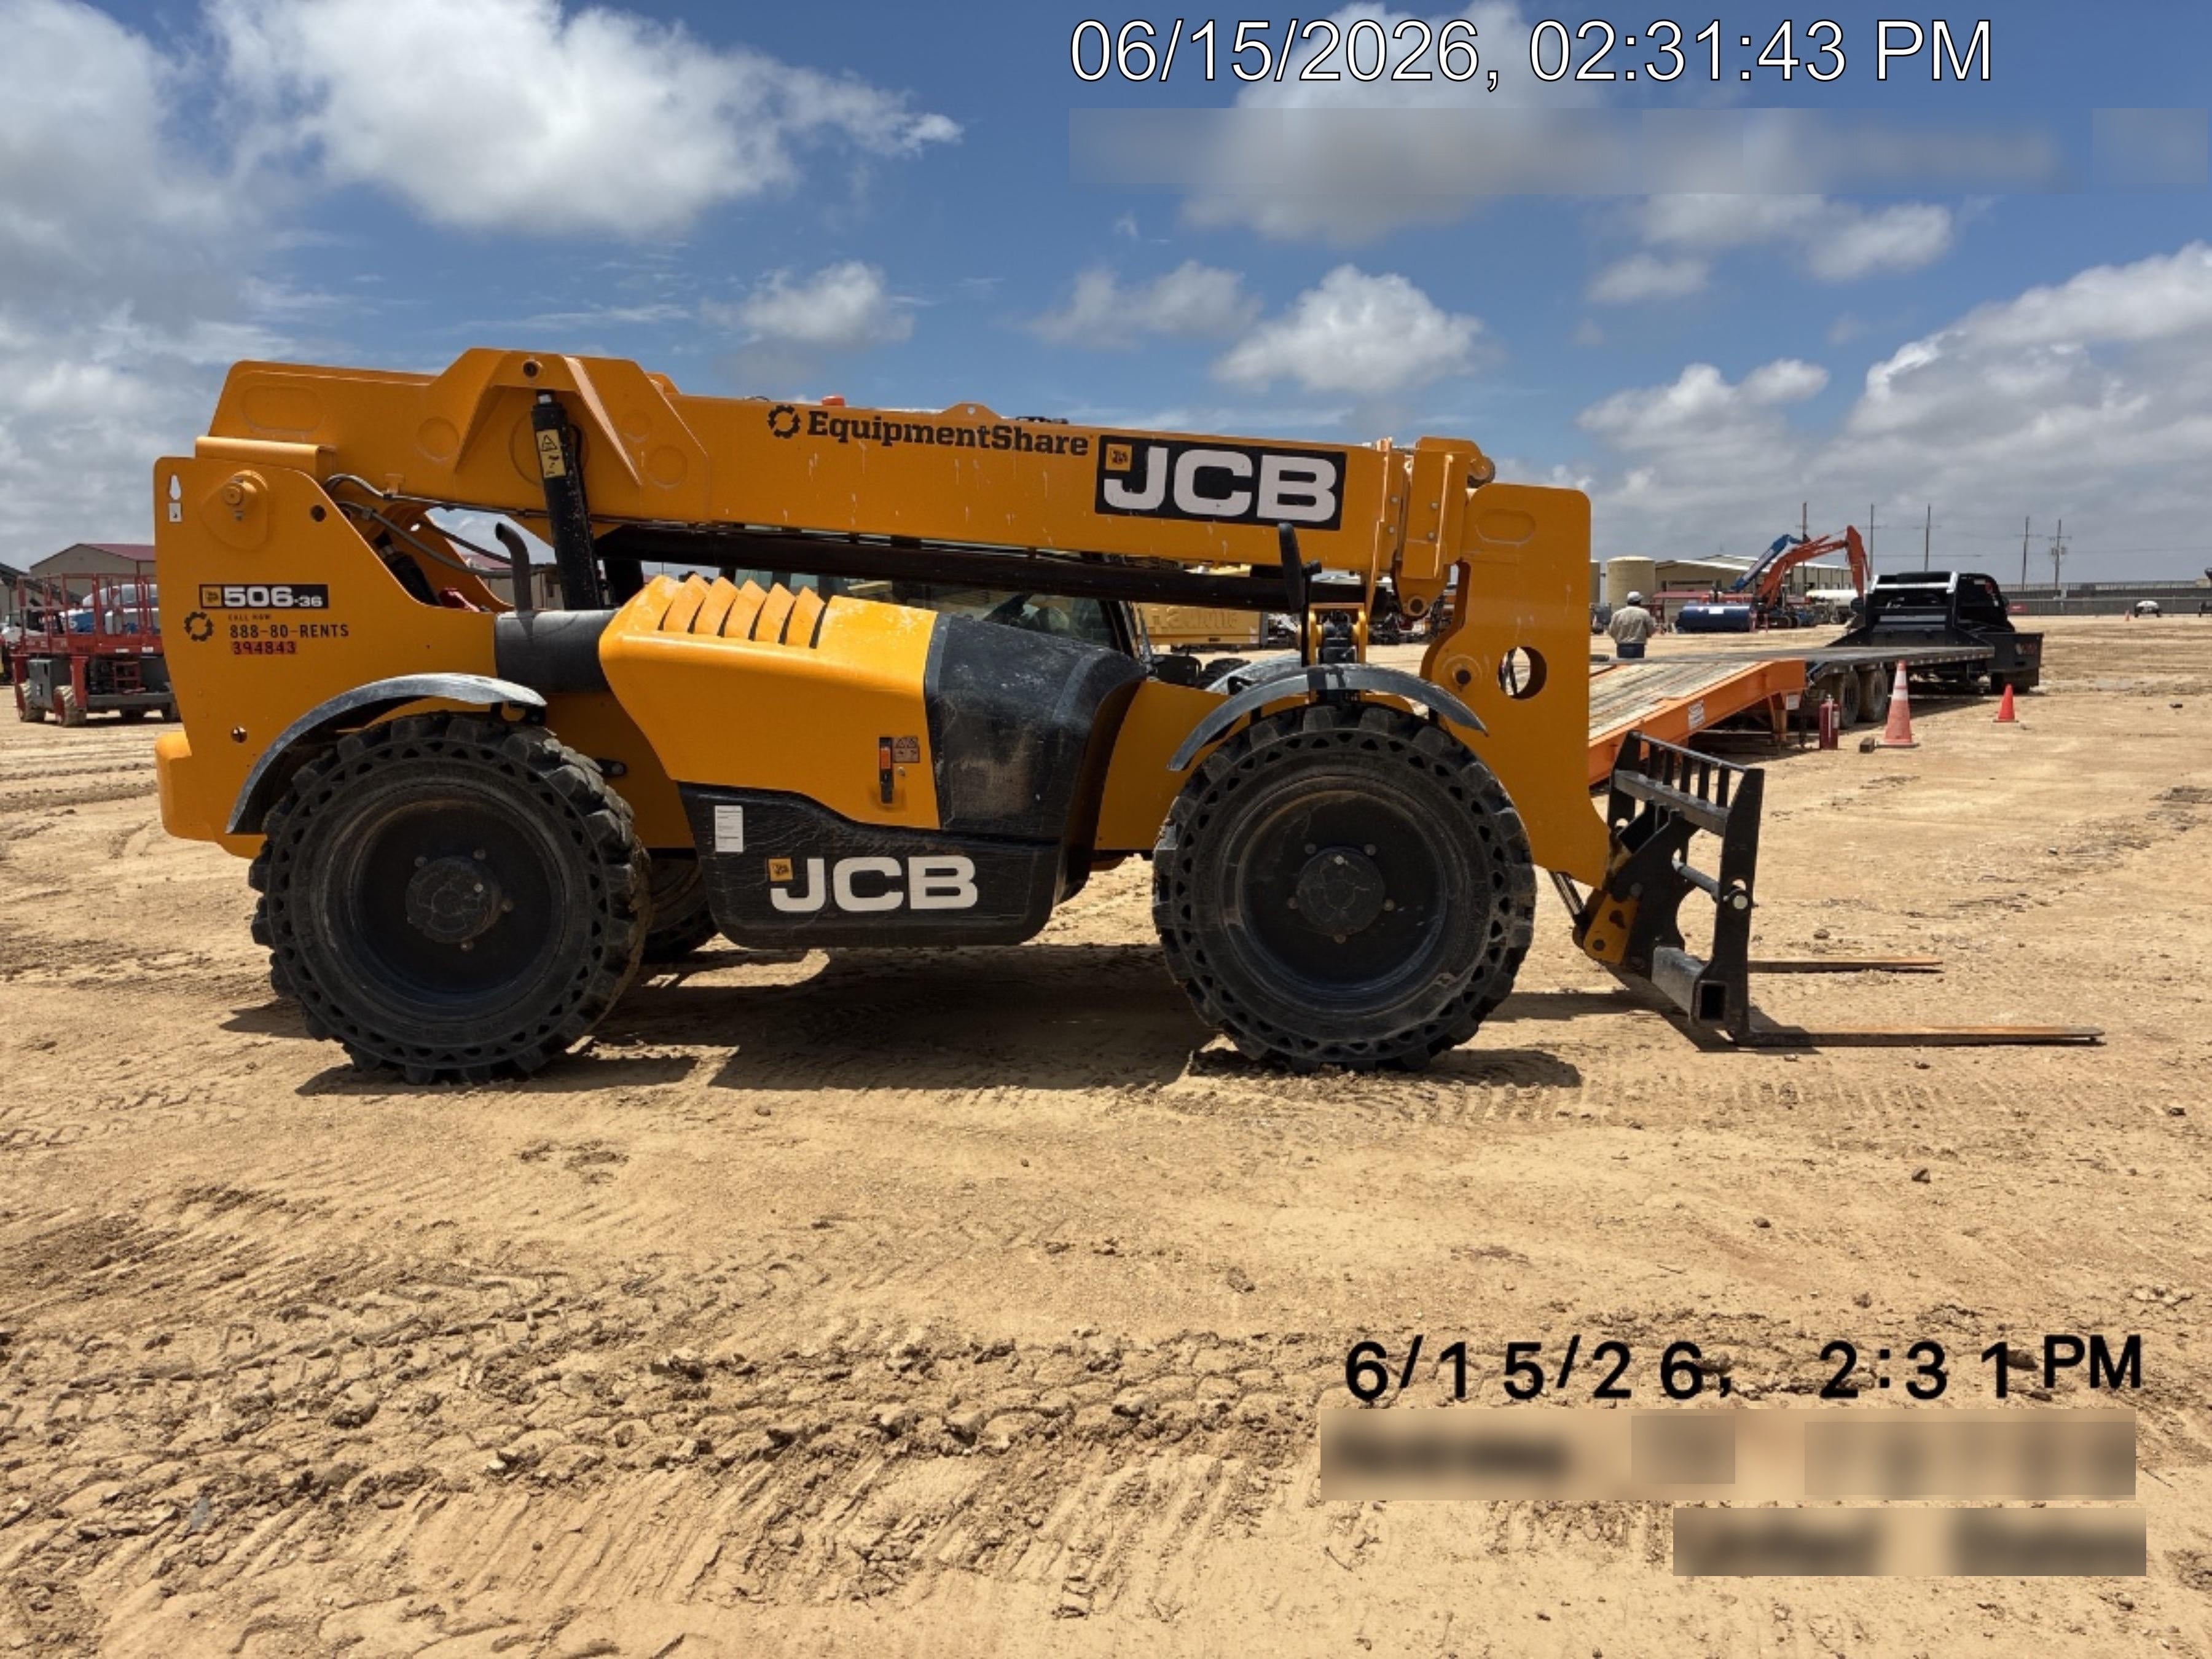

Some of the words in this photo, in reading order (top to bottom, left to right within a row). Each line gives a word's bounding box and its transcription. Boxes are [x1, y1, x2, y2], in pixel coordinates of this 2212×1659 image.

[808, 410, 1089, 456] EquipmentShare
[1104, 446, 1337, 522] JCB
[230, 624, 349, 638] 888-80-RENTS
[233, 641, 296, 655] 394843
[771, 855, 978, 912] JCB
